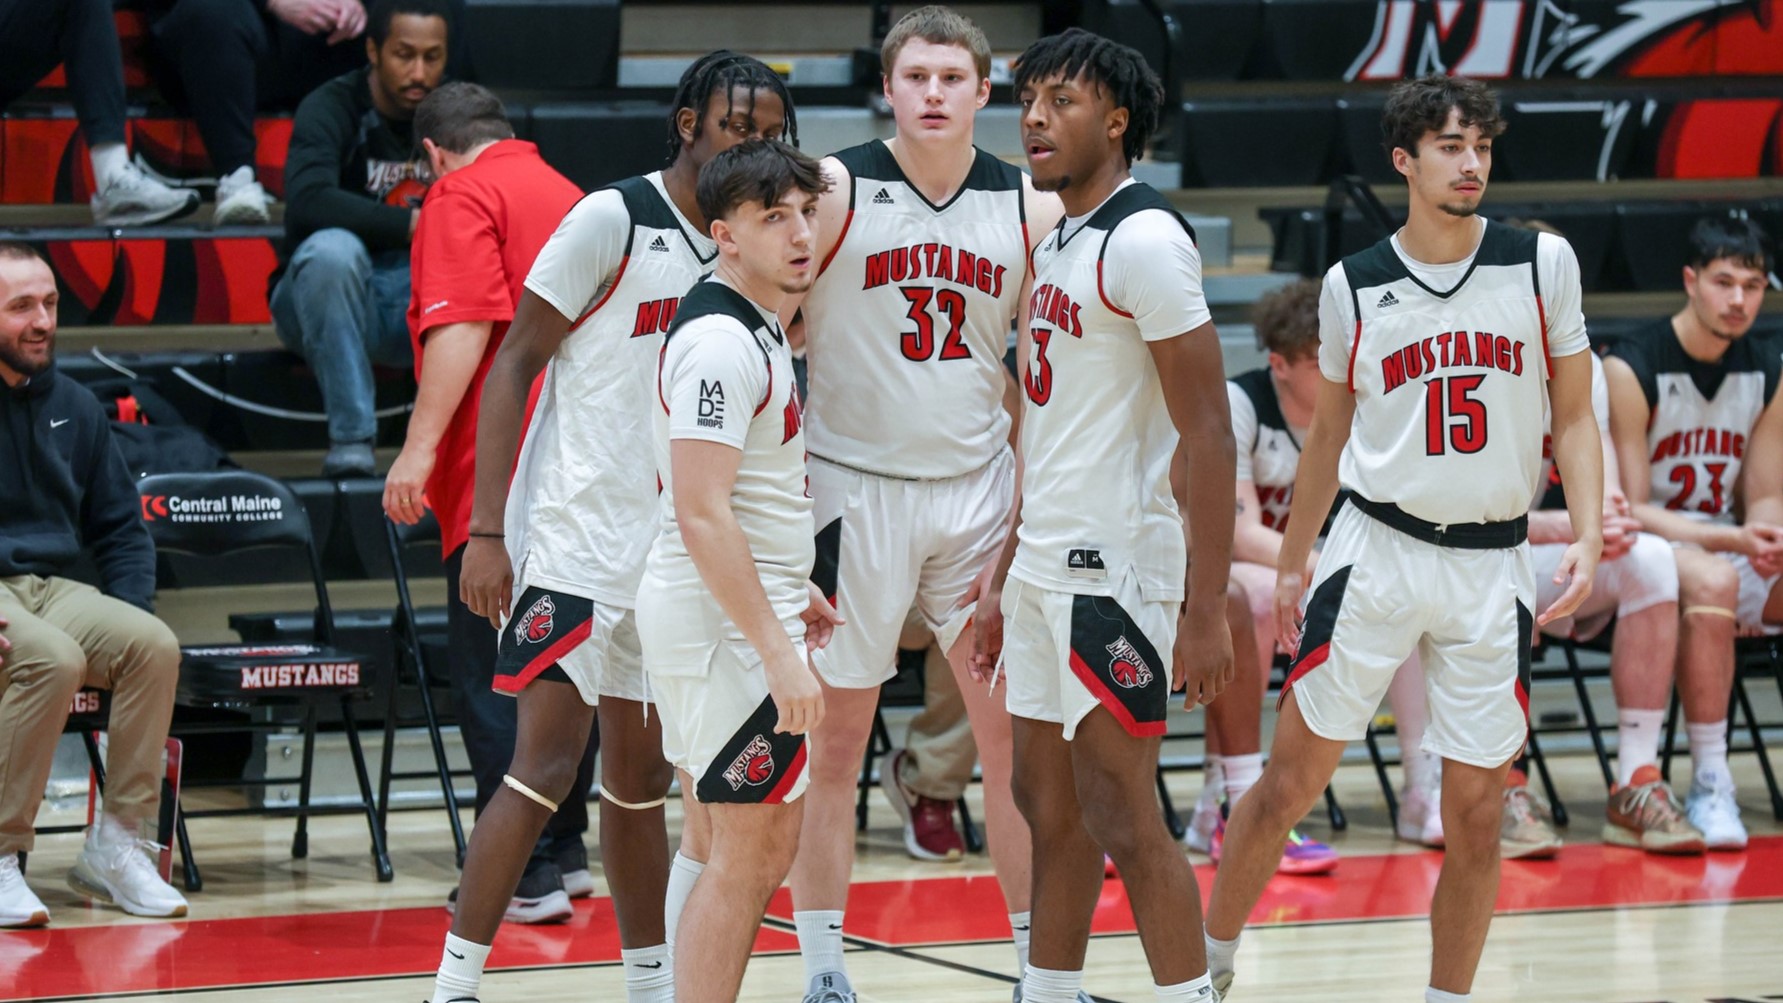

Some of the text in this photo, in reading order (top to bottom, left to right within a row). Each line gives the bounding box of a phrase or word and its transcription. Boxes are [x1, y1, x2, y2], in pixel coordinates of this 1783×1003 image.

[862, 243, 1007, 299] MUSTANGS
[630, 296, 685, 338] MU
[899, 286, 972, 362] 32
[1377, 299, 1399, 309] adidas
[1381, 331, 1525, 395] MUSTANGS
[697, 418, 724, 430] HOOPS
[1424, 374, 1488, 456] 15
[1649, 427, 1745, 464] MUSTANG
[168, 494, 282, 512] Central Maine
[1664, 463, 1728, 515] 23
[172, 511, 283, 522] COMMUNITY COLLEGE
[515, 596, 554, 645] MUSTANGS
[241, 663, 360, 689] MUSTANGS
[1107, 637, 1152, 687] MUSTANGS
[70, 691, 100, 713] GS
[724, 736, 771, 790] MUSTANGS
